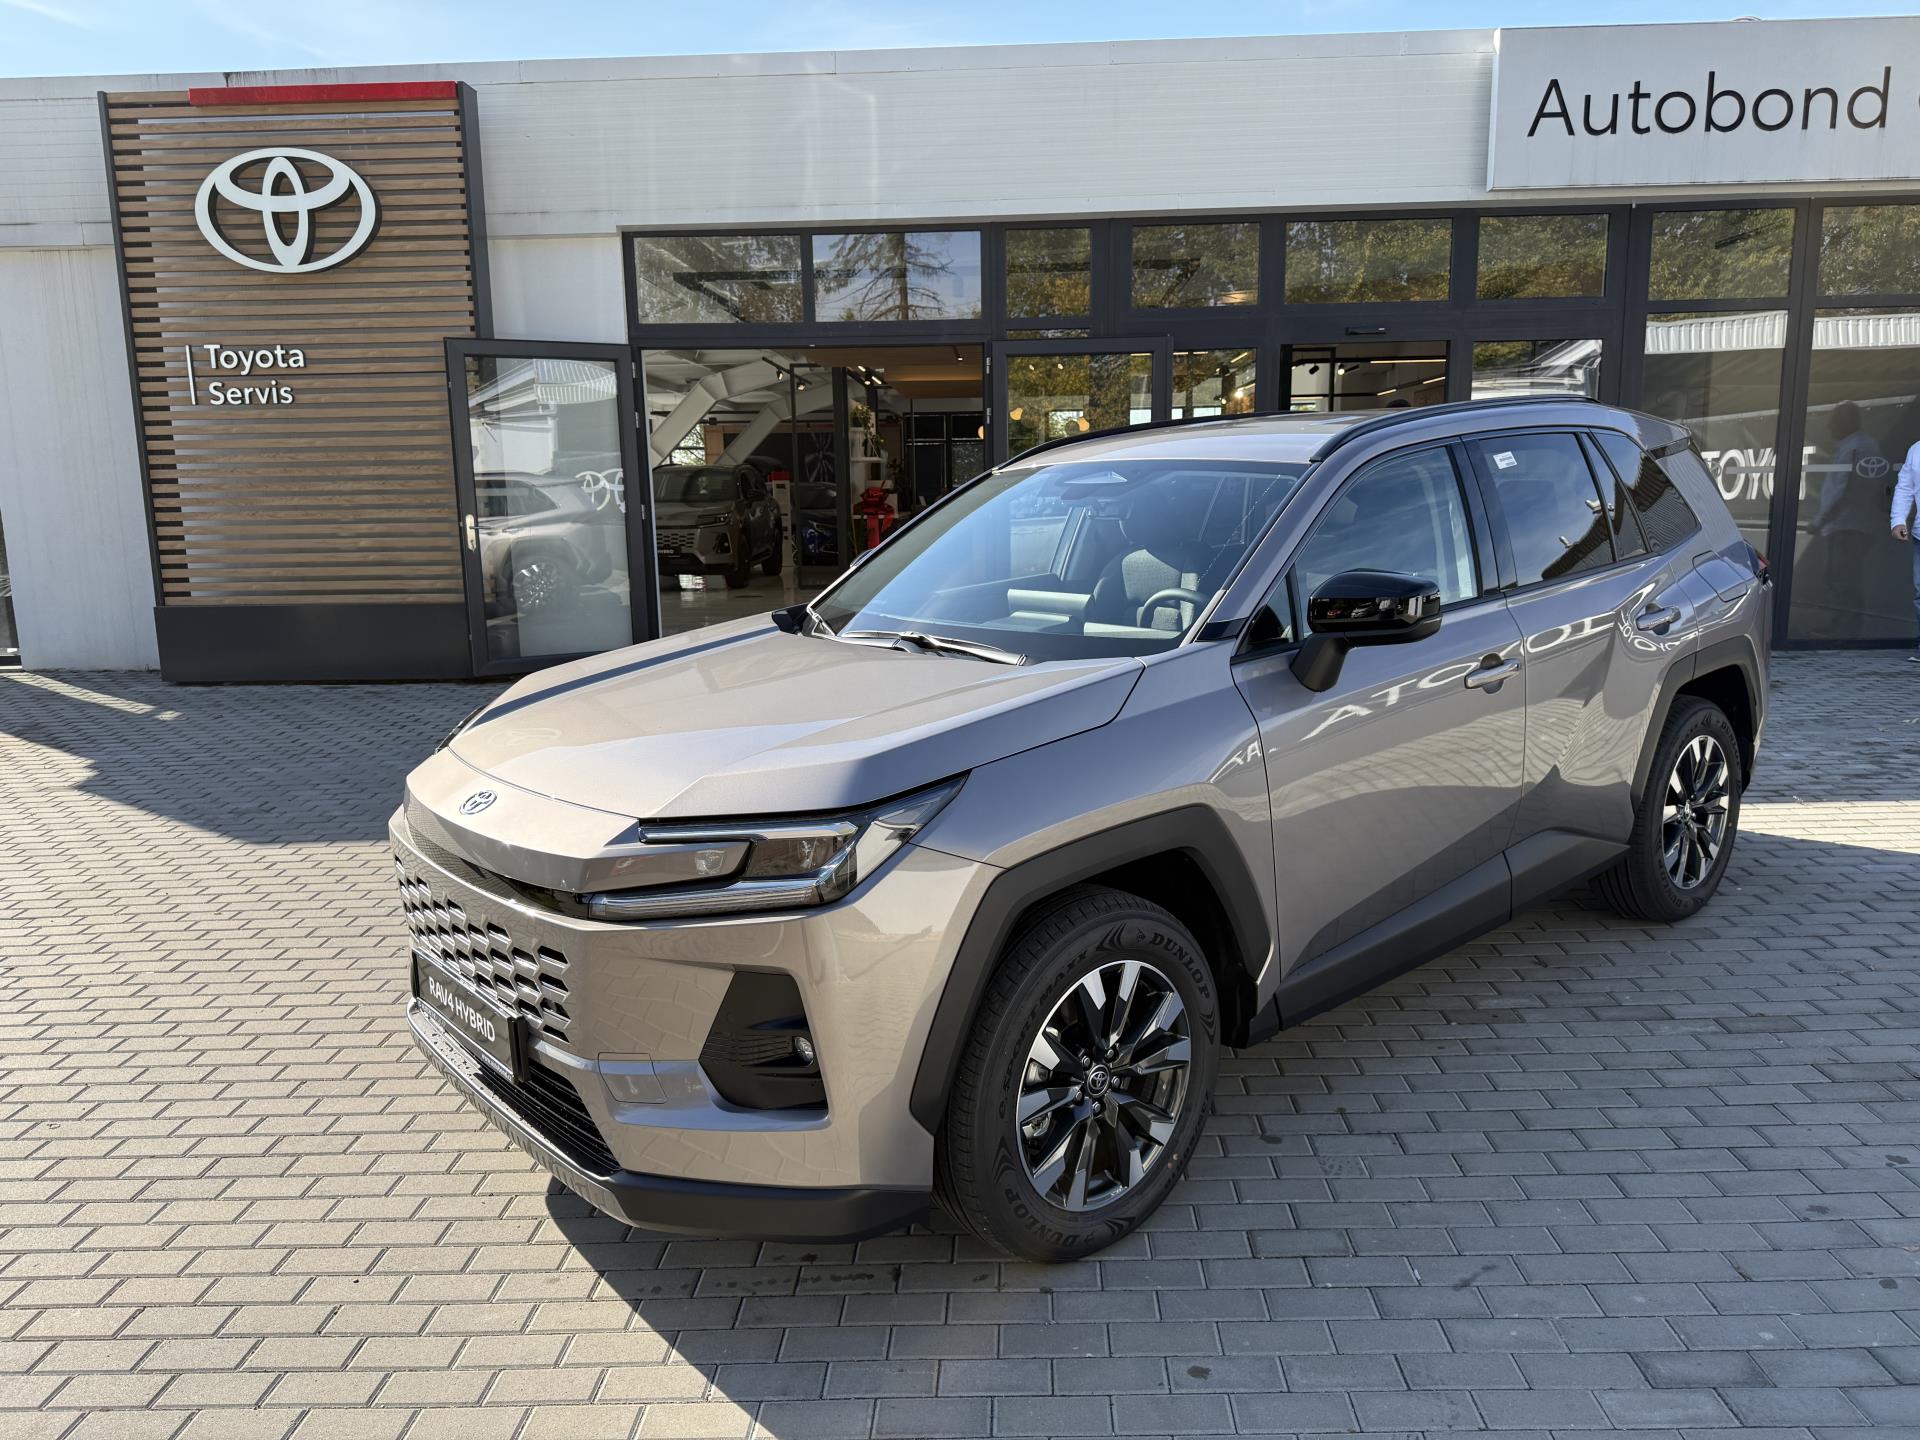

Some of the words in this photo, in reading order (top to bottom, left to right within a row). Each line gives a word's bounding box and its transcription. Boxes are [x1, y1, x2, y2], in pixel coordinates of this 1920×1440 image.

[1527, 66, 1892, 137] Autobond
[203, 344, 305, 376] Toyota
[208, 380, 294, 405] Servis
[1150, 932, 1210, 999] DUNLOP
[428, 975, 455, 1012] RAV4
[454, 996, 496, 1042] HYBRID
[1004, 1187, 1081, 1248] DUNLOP
